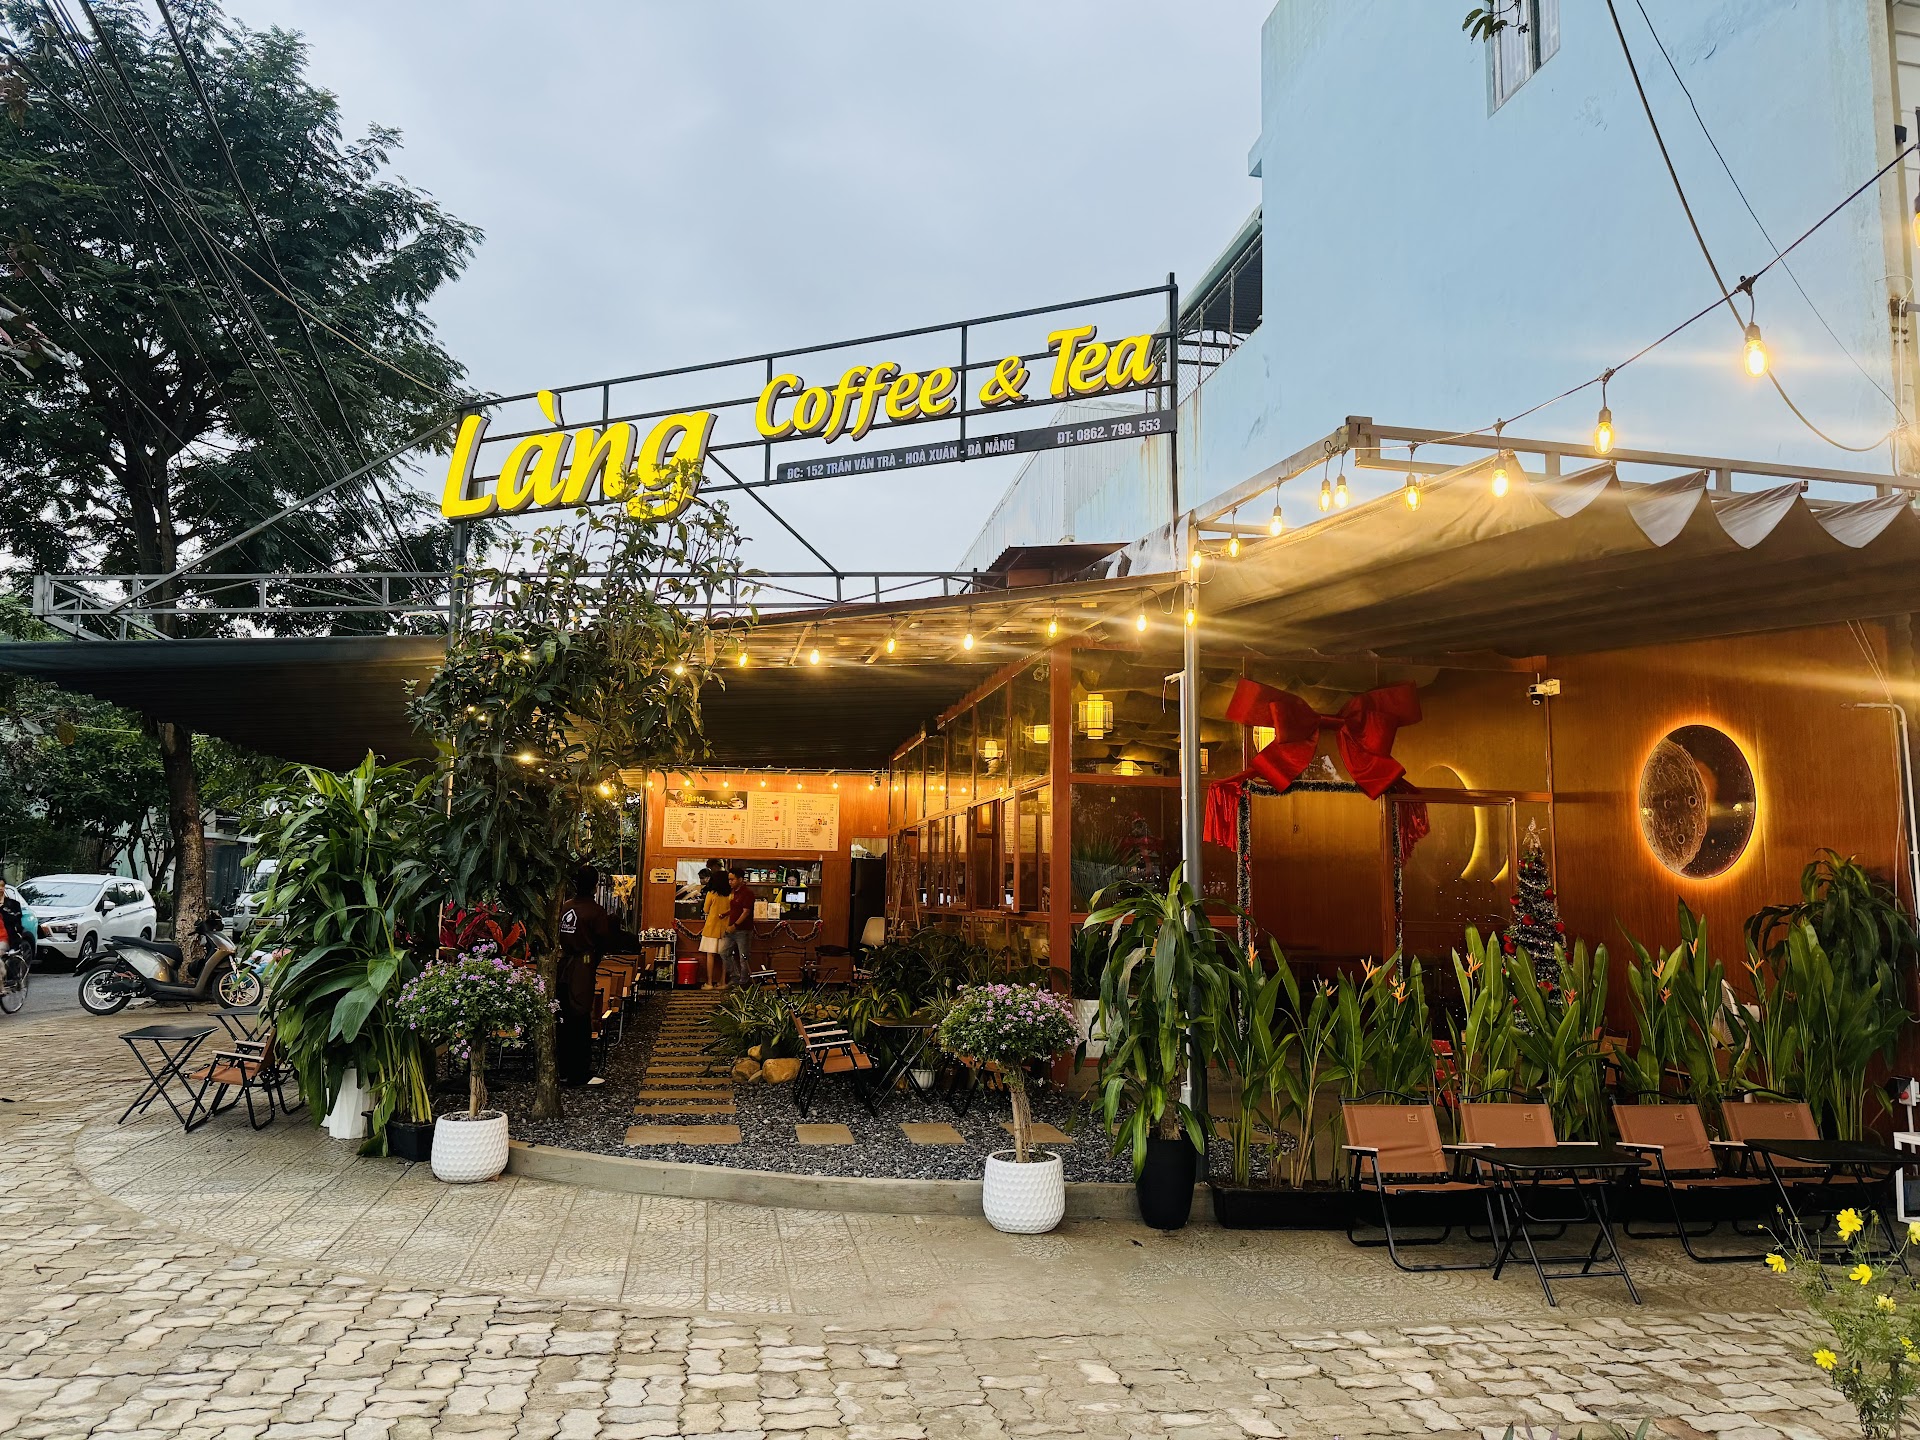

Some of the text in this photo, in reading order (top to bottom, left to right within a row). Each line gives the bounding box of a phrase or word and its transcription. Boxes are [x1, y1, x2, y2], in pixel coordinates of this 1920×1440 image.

[755, 325, 1156, 442] Coffee & Tea
[441, 390, 717, 522] Làng
[787, 467, 803, 480] ĐC:
[806, 464, 824, 477] 152
[826, 457, 851, 474] TRẦN
[854, 455, 874, 470] VĂN
[877, 453, 896, 468] TRÀ
[905, 450, 926, 465] HOÀ
[928, 445, 958, 462] XUÂN
[967, 441, 982, 456] ĐÀ
[985, 437, 1015, 453] NẴNG
[1057, 418, 1161, 444] ĐT: 0862. 799. 553
